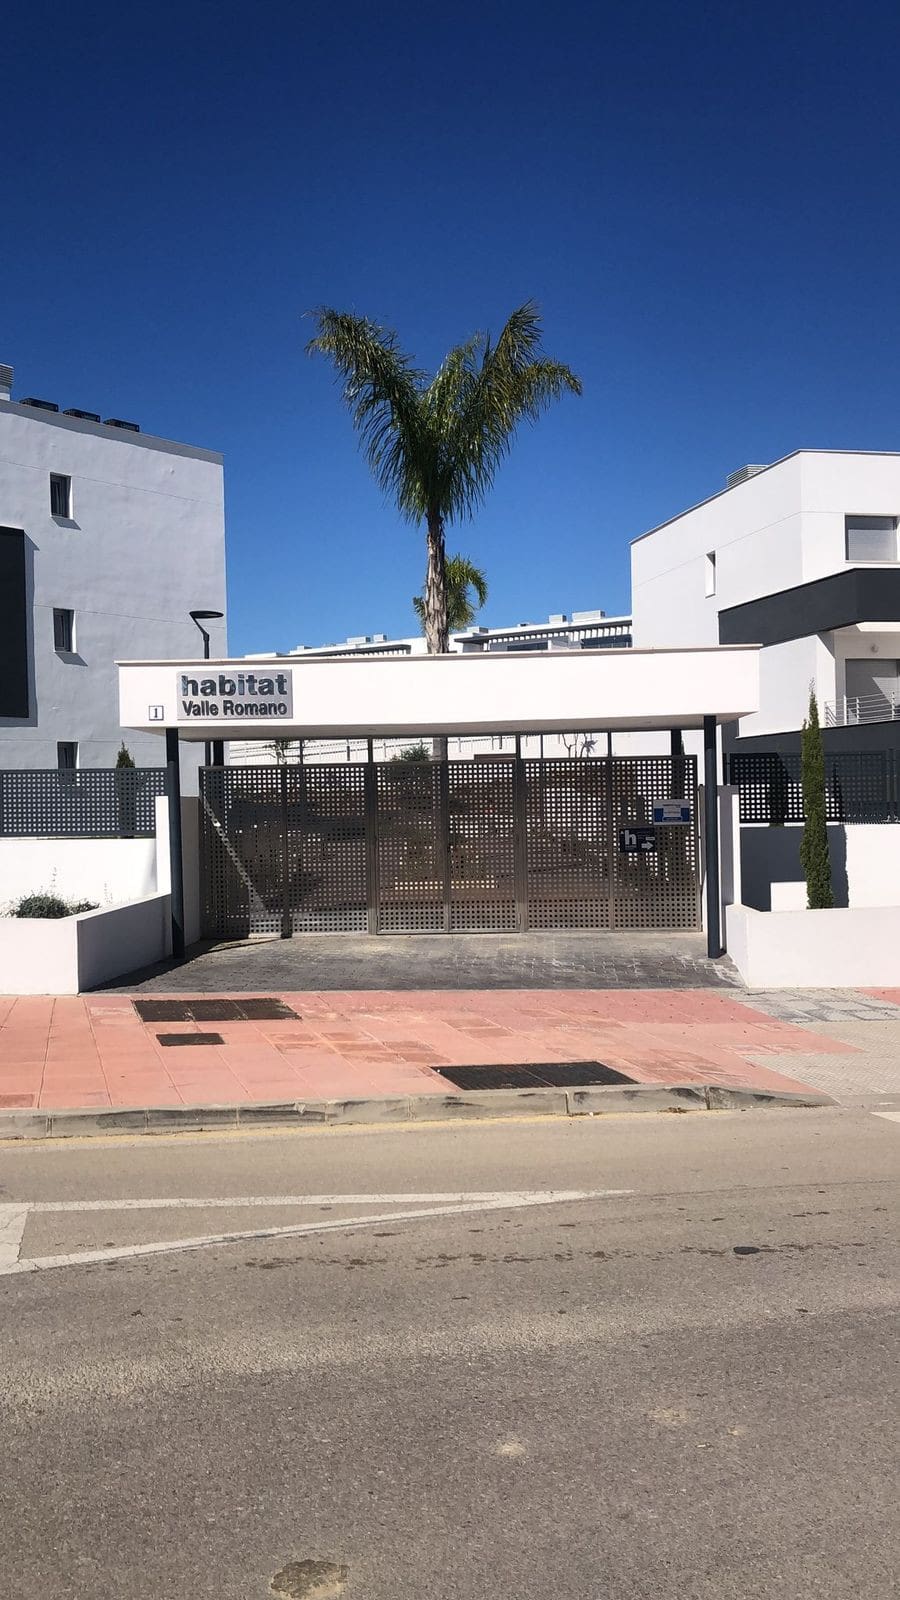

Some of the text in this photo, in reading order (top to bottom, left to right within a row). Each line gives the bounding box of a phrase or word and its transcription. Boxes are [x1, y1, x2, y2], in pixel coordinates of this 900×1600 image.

[181, 674, 288, 696] habitat
[182, 699, 288, 716] Valle Romano
[624, 829, 637, 845] h
